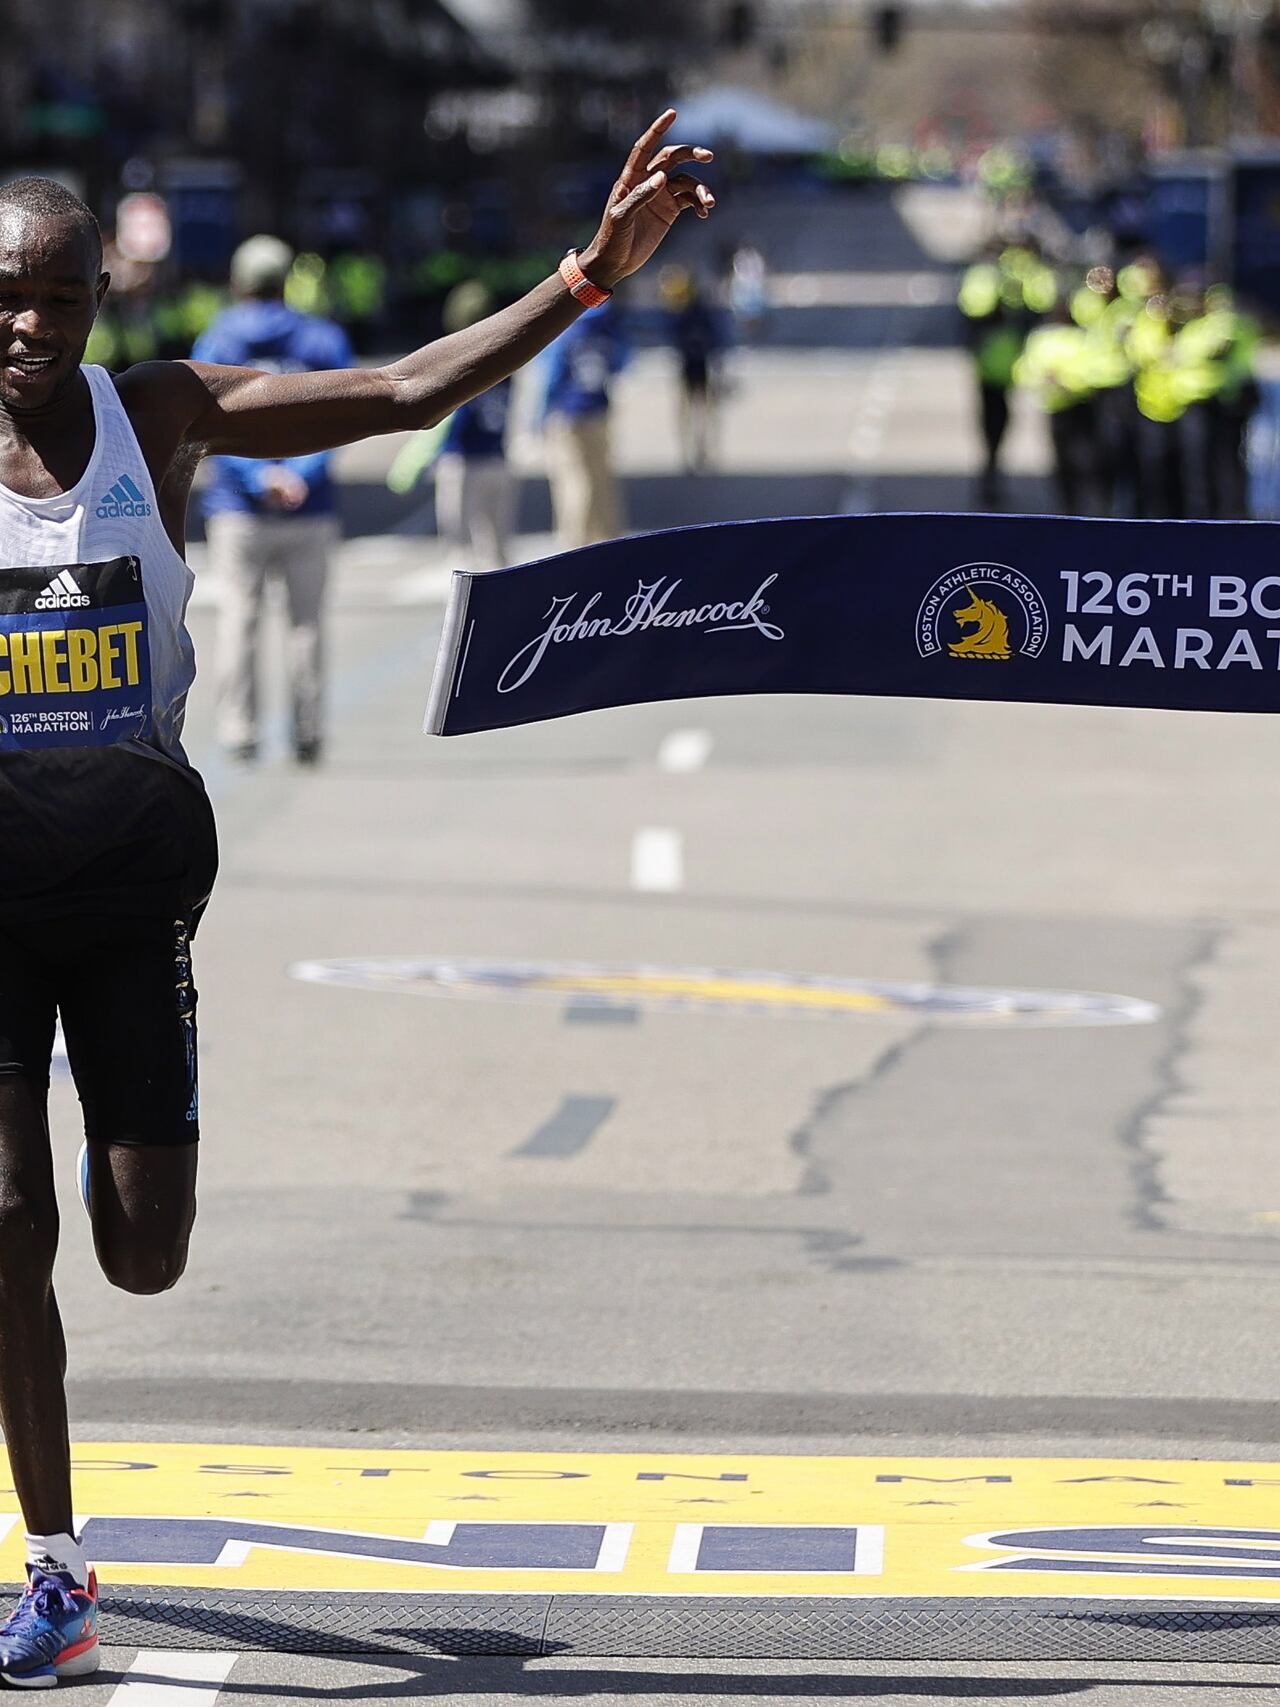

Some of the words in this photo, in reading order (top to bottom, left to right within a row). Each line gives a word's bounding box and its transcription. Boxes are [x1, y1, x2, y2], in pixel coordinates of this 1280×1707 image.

[95, 501, 152, 519] adidas
[34, 592, 91, 610] adidas
[1059, 570, 1193, 616] 126TH
[921, 595, 941, 652] BOSTON
[938, 567, 1001, 596] ATHLETIC
[1001, 573, 1043, 653] ASSOCIATION
[496, 591, 612, 694] John
[10, 712, 38, 724] 126TH
[39, 711, 88, 722] BOSTON
[99, 708, 121, 731] John
